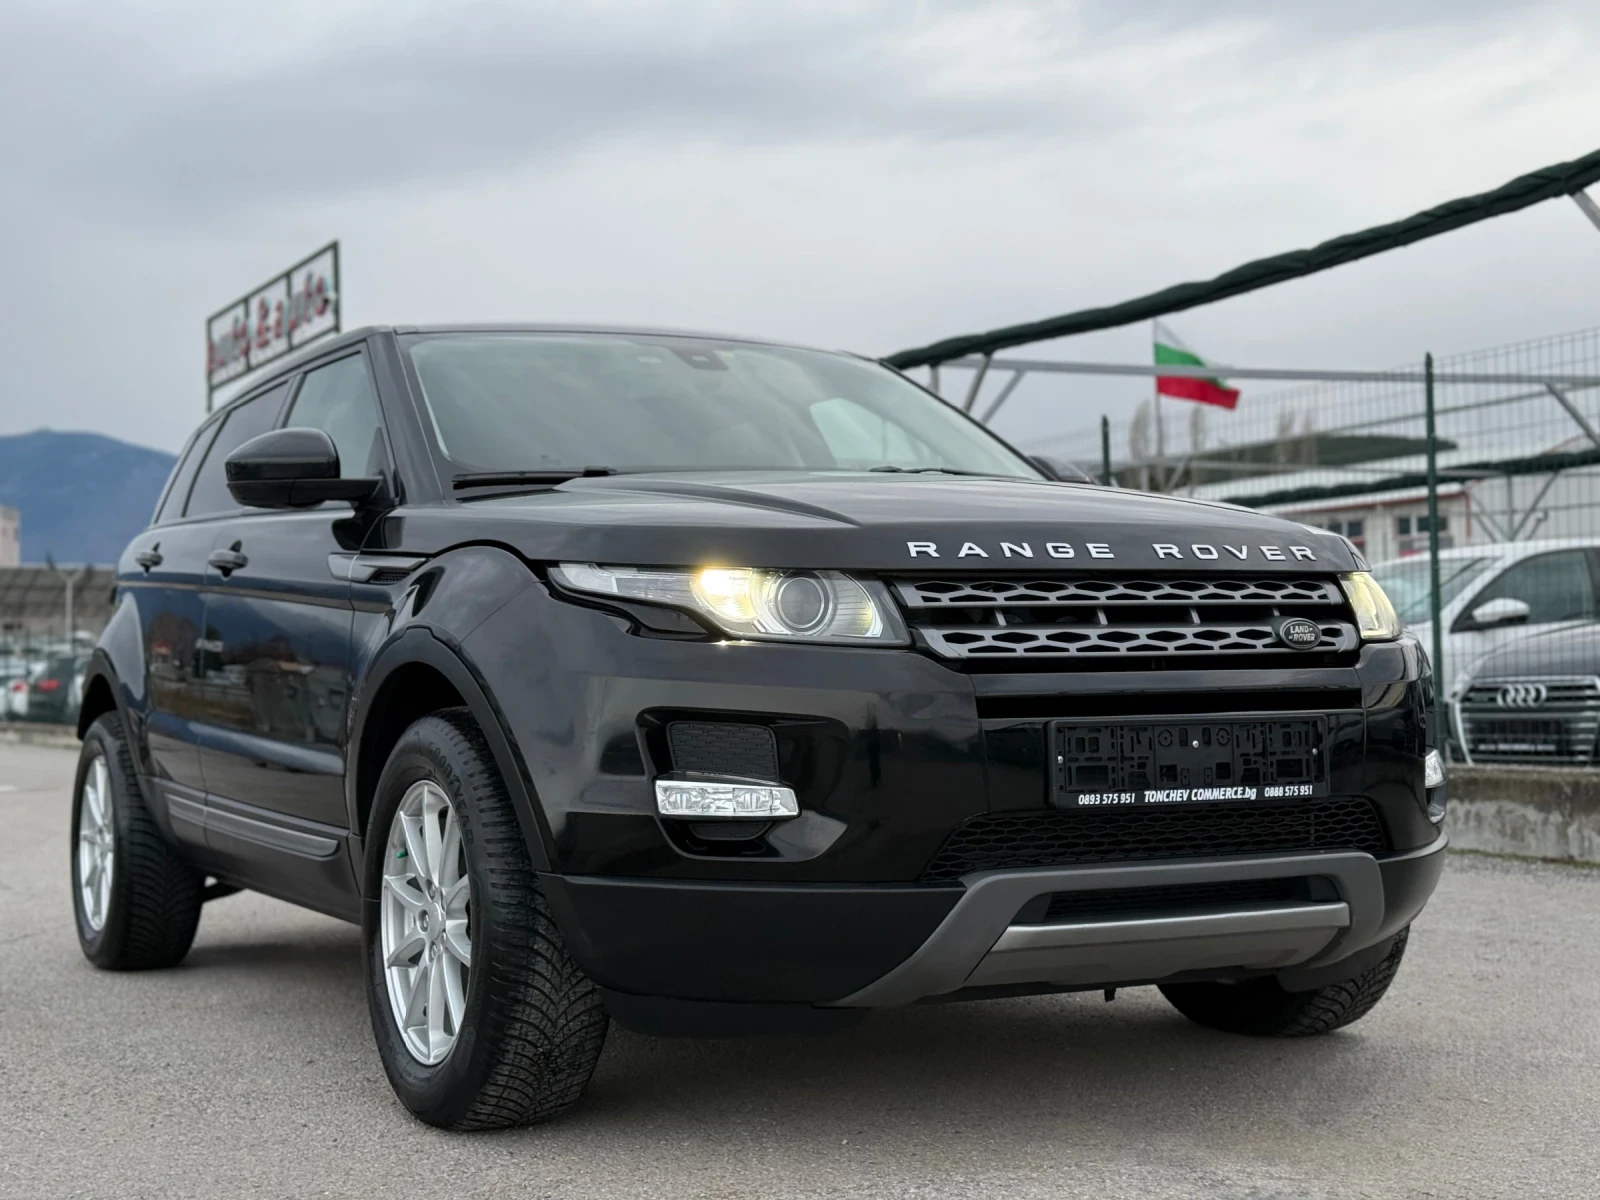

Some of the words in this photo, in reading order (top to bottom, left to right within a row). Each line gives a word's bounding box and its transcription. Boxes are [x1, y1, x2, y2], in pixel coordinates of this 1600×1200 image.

[906, 541, 1115, 560] RANGE
[1152, 543, 1317, 562] ROVER
[1078, 794, 1101, 805] 0893
[1102, 793, 1119, 804] 575
[1120, 792, 1136, 804] 951
[1144, 789, 1190, 803] TONCHEV
[1191, 786, 1257, 801] COMMERCE.bg
[1264, 786, 1284, 798] 0888
[1285, 785, 1299, 797] 575
[1299, 785, 1313, 796] 951
